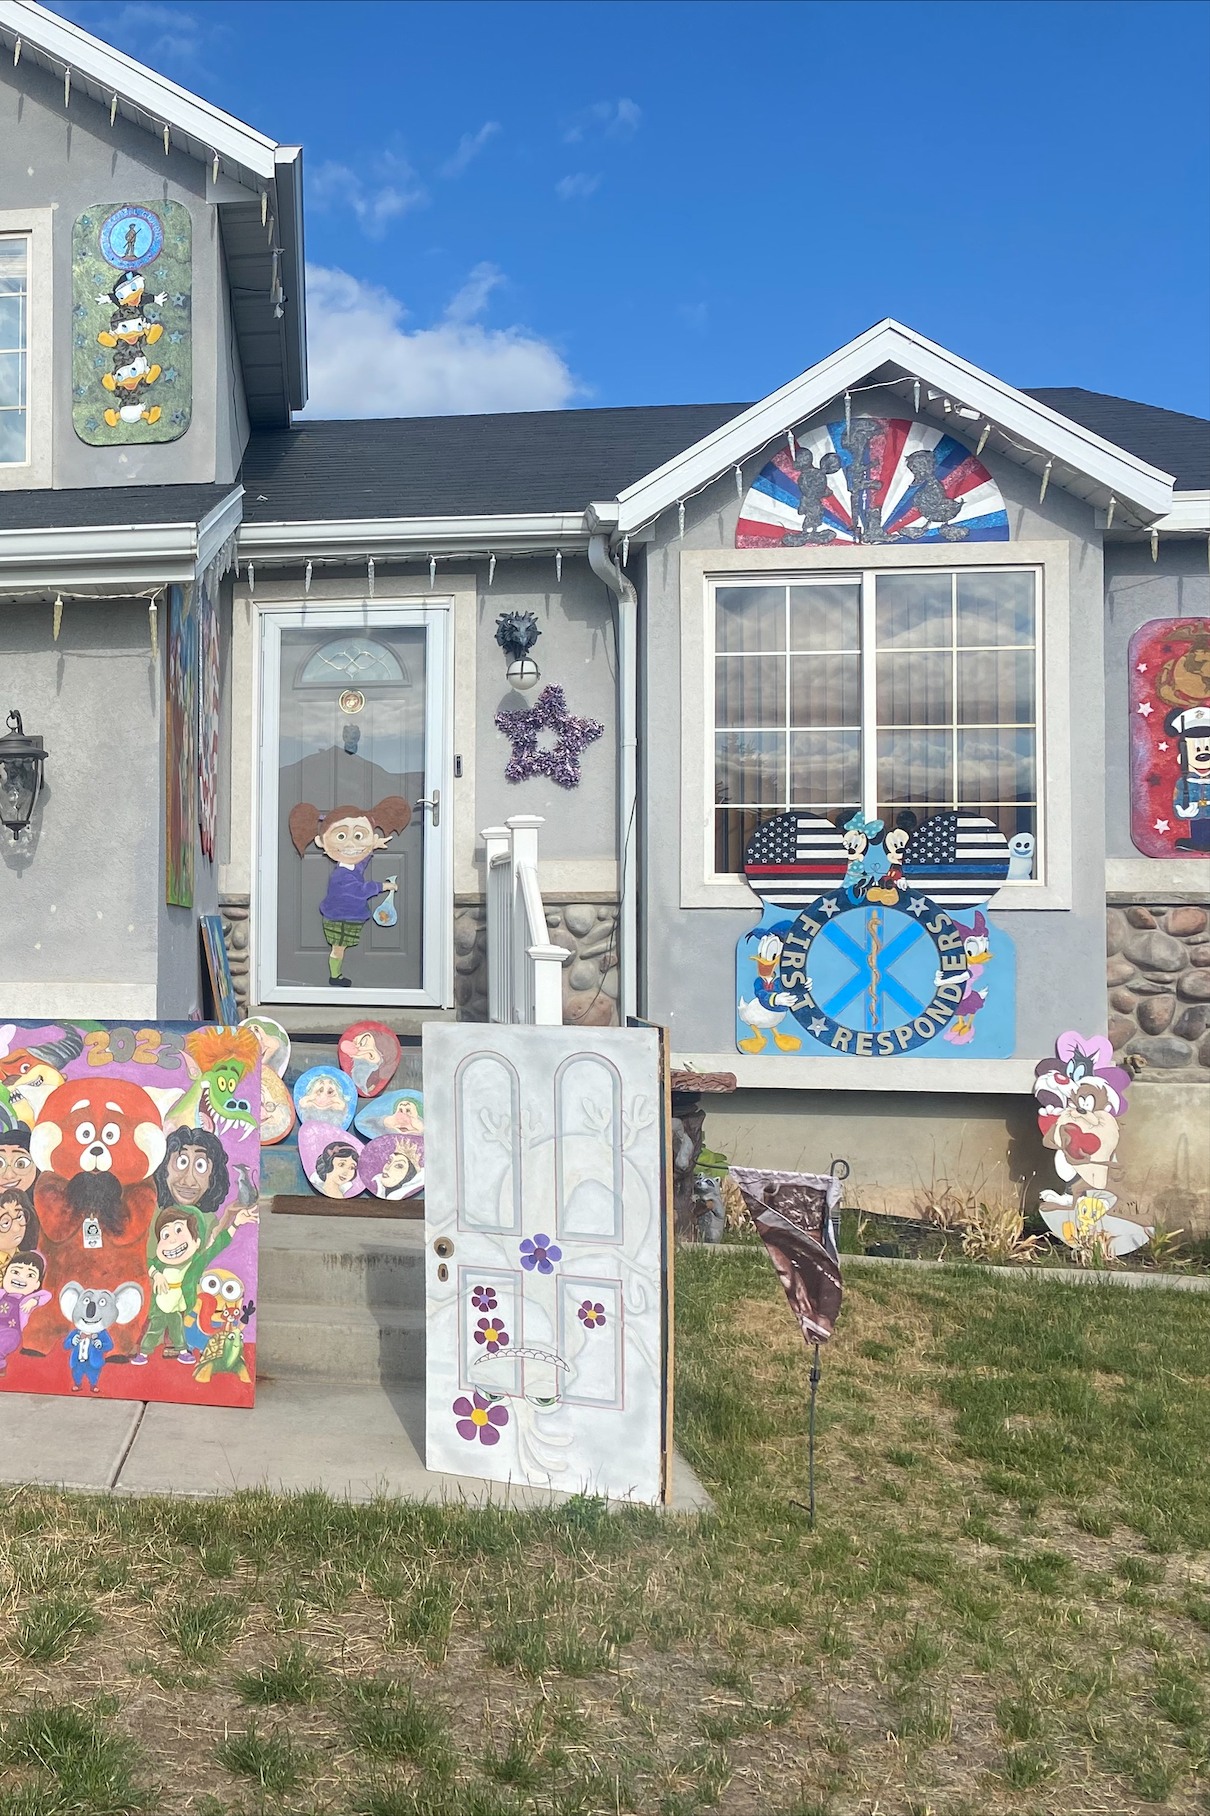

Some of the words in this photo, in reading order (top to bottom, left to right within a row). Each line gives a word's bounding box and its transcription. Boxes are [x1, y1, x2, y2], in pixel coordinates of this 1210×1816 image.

[781, 914, 822, 1013] FIRST
[831, 913, 967, 1057] RESPONDERS
[84, 1026, 186, 1070] 2022
